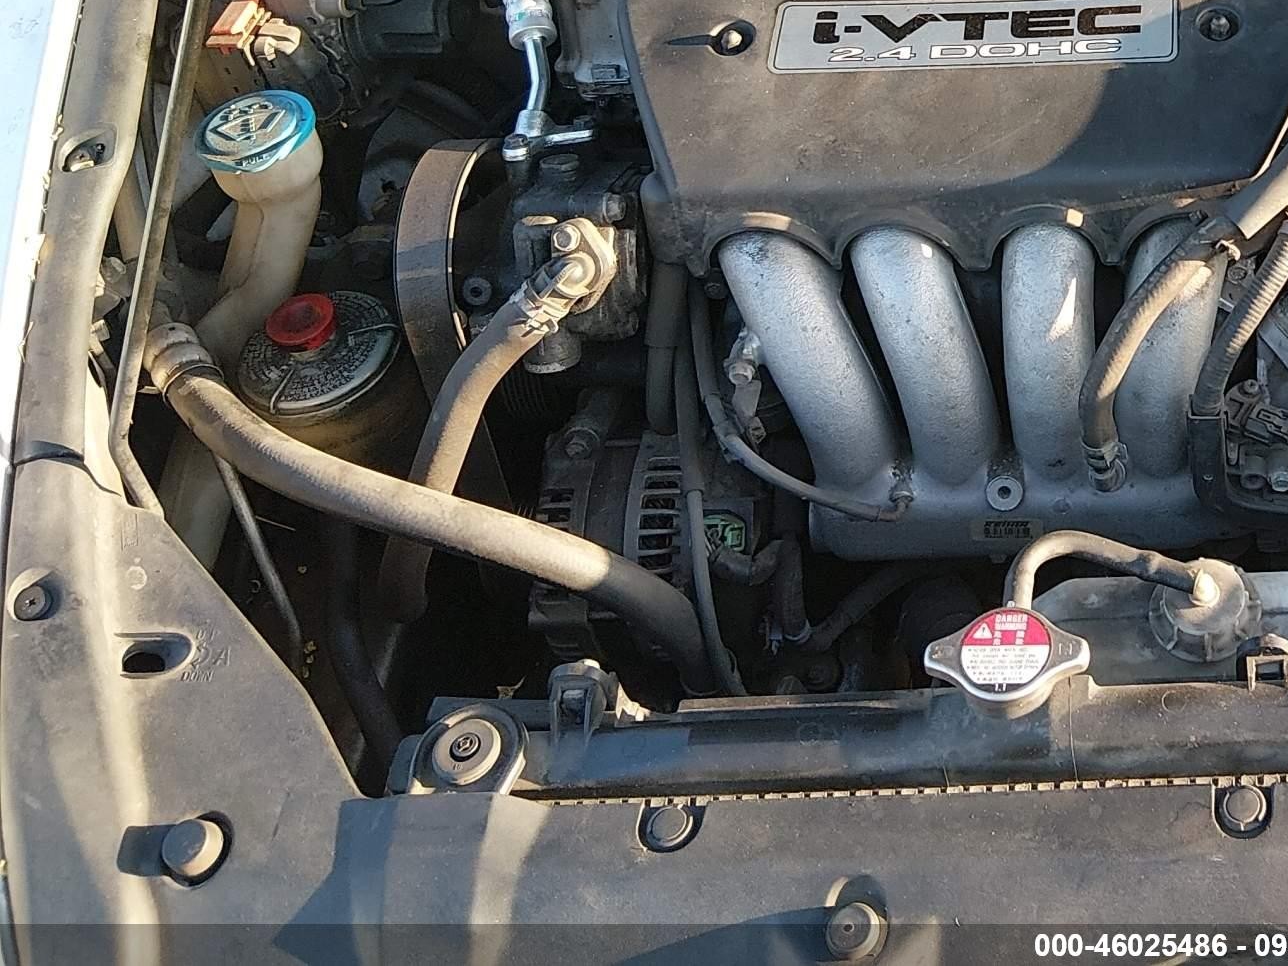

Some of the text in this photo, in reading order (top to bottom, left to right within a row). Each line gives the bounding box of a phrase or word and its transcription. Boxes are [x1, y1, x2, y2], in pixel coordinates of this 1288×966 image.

[812, 5, 1143, 45] i-VTEC
[828, 37, 1123, 63] 2.4 DOHC
[995, 614, 1029, 623] DANGER
